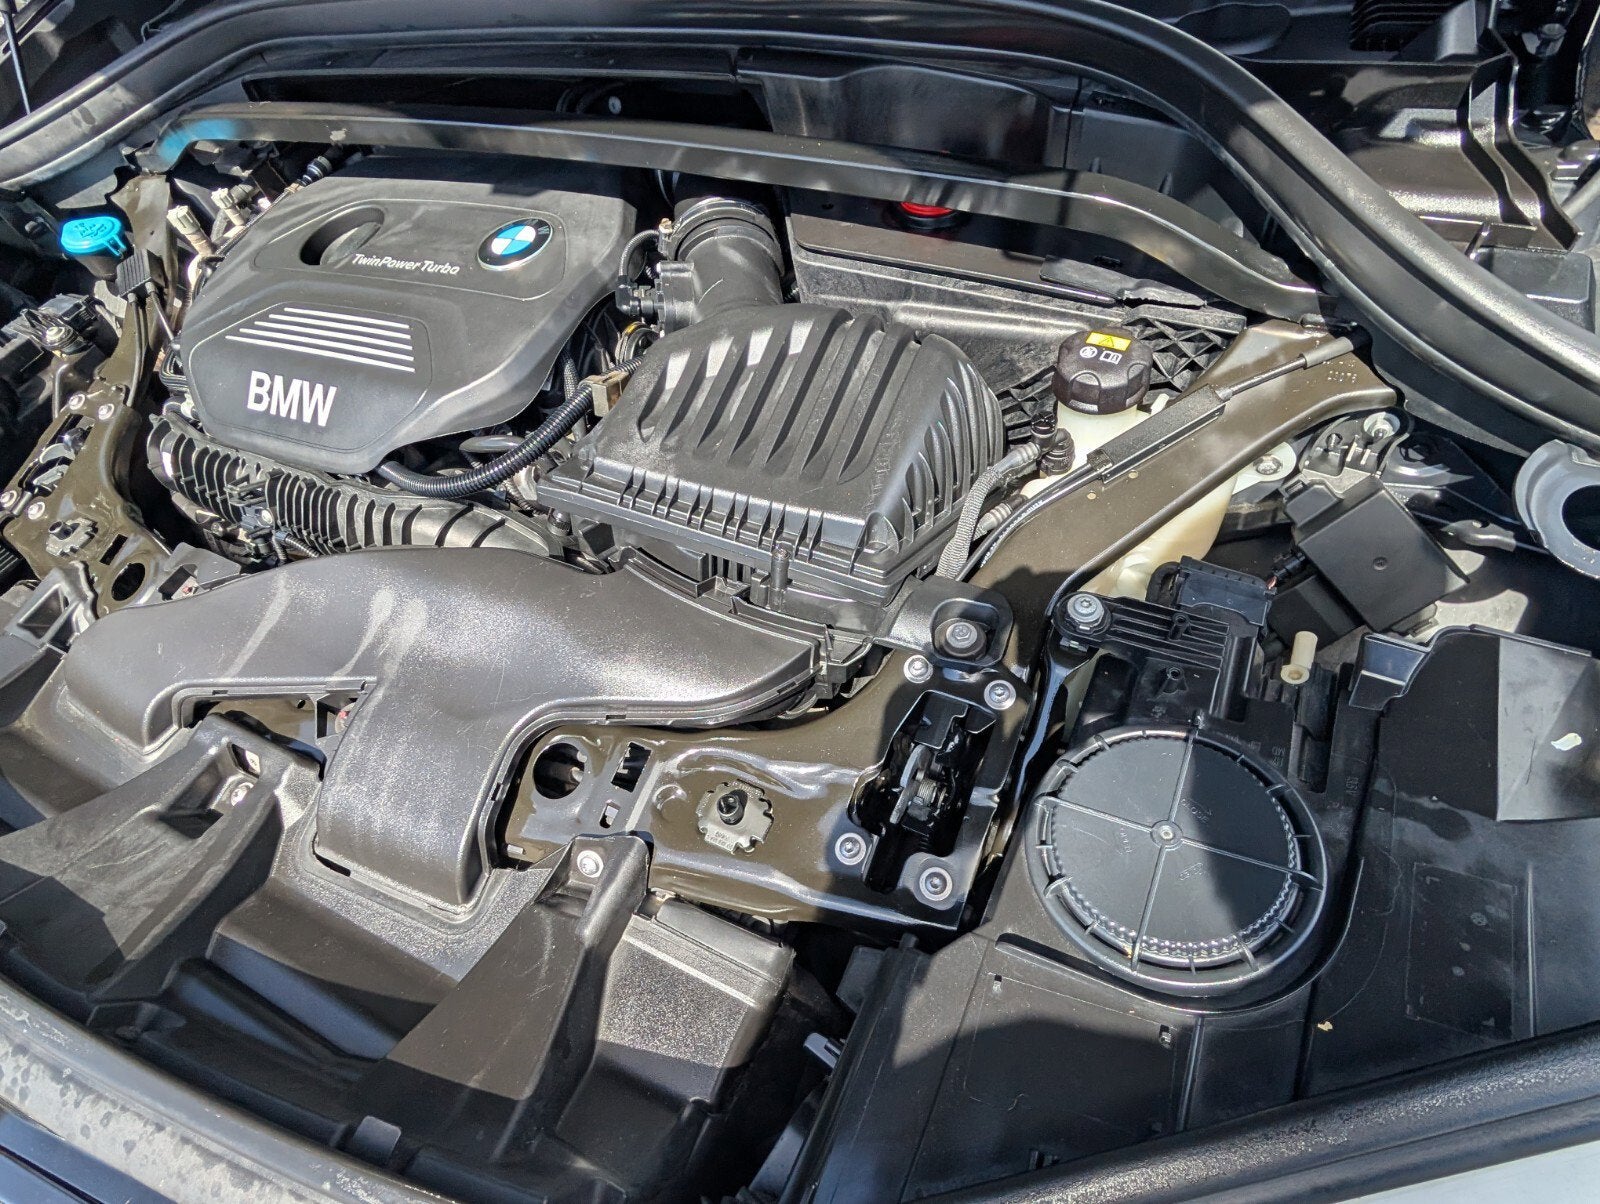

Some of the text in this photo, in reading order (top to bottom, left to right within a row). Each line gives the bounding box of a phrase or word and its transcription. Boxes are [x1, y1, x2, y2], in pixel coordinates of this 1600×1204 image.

[352, 253, 460, 275] TwinPower Turbo
[247, 370, 338, 427] BMW
